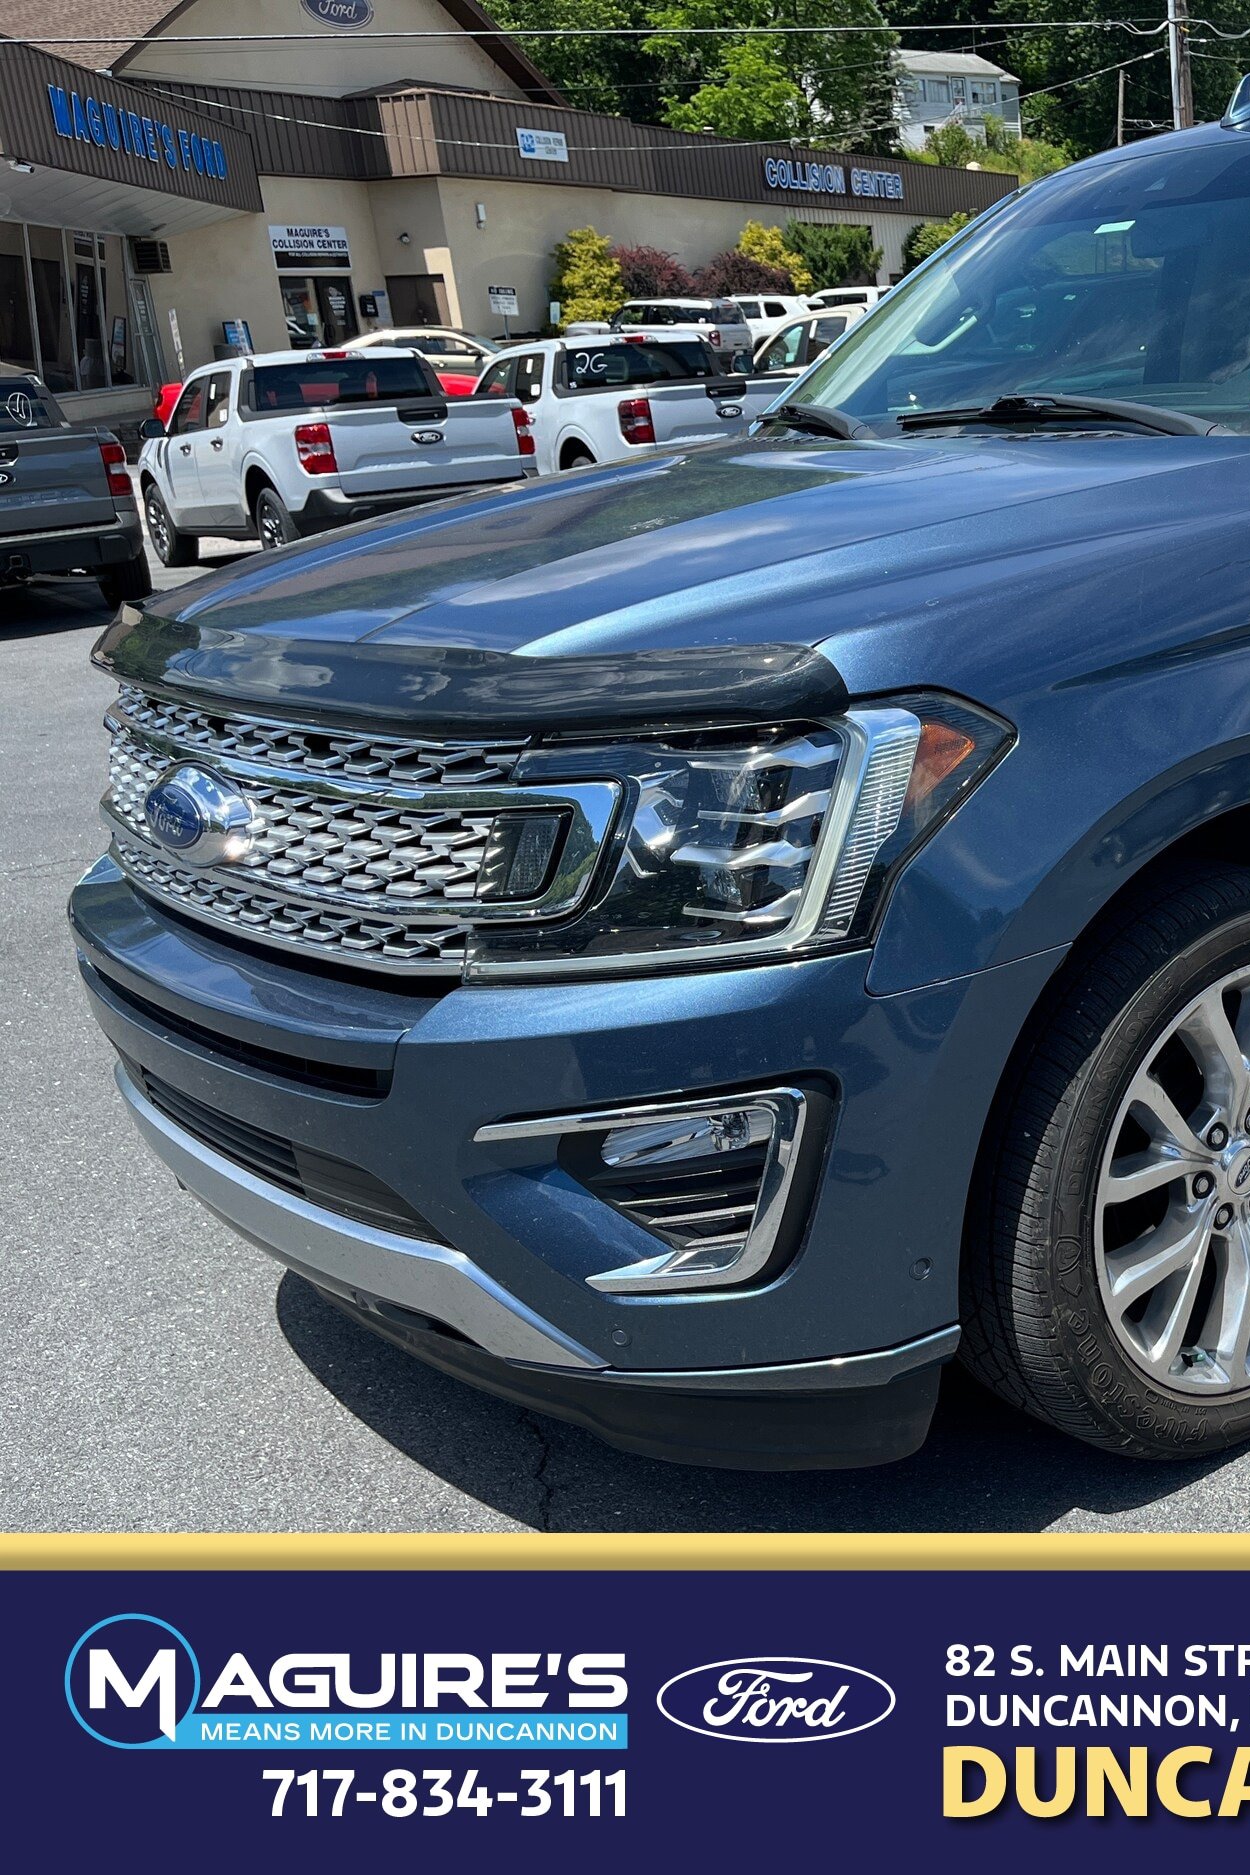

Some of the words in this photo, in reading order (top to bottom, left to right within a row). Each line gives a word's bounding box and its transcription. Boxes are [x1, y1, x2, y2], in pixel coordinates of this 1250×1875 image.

[318, 0, 358, 19] Ford
[47, 83, 177, 170] MAGUIRE'S
[178, 129, 228, 180] FORD
[765, 157, 846, 194] COLLISION
[851, 168, 904, 199] CENTER
[272, 239, 315, 249] COLLISION
[317, 239, 348, 249] CENTER
[286, 228, 330, 238] MAGUIRE'S
[1066, 1307, 1209, 1445] Firestone
